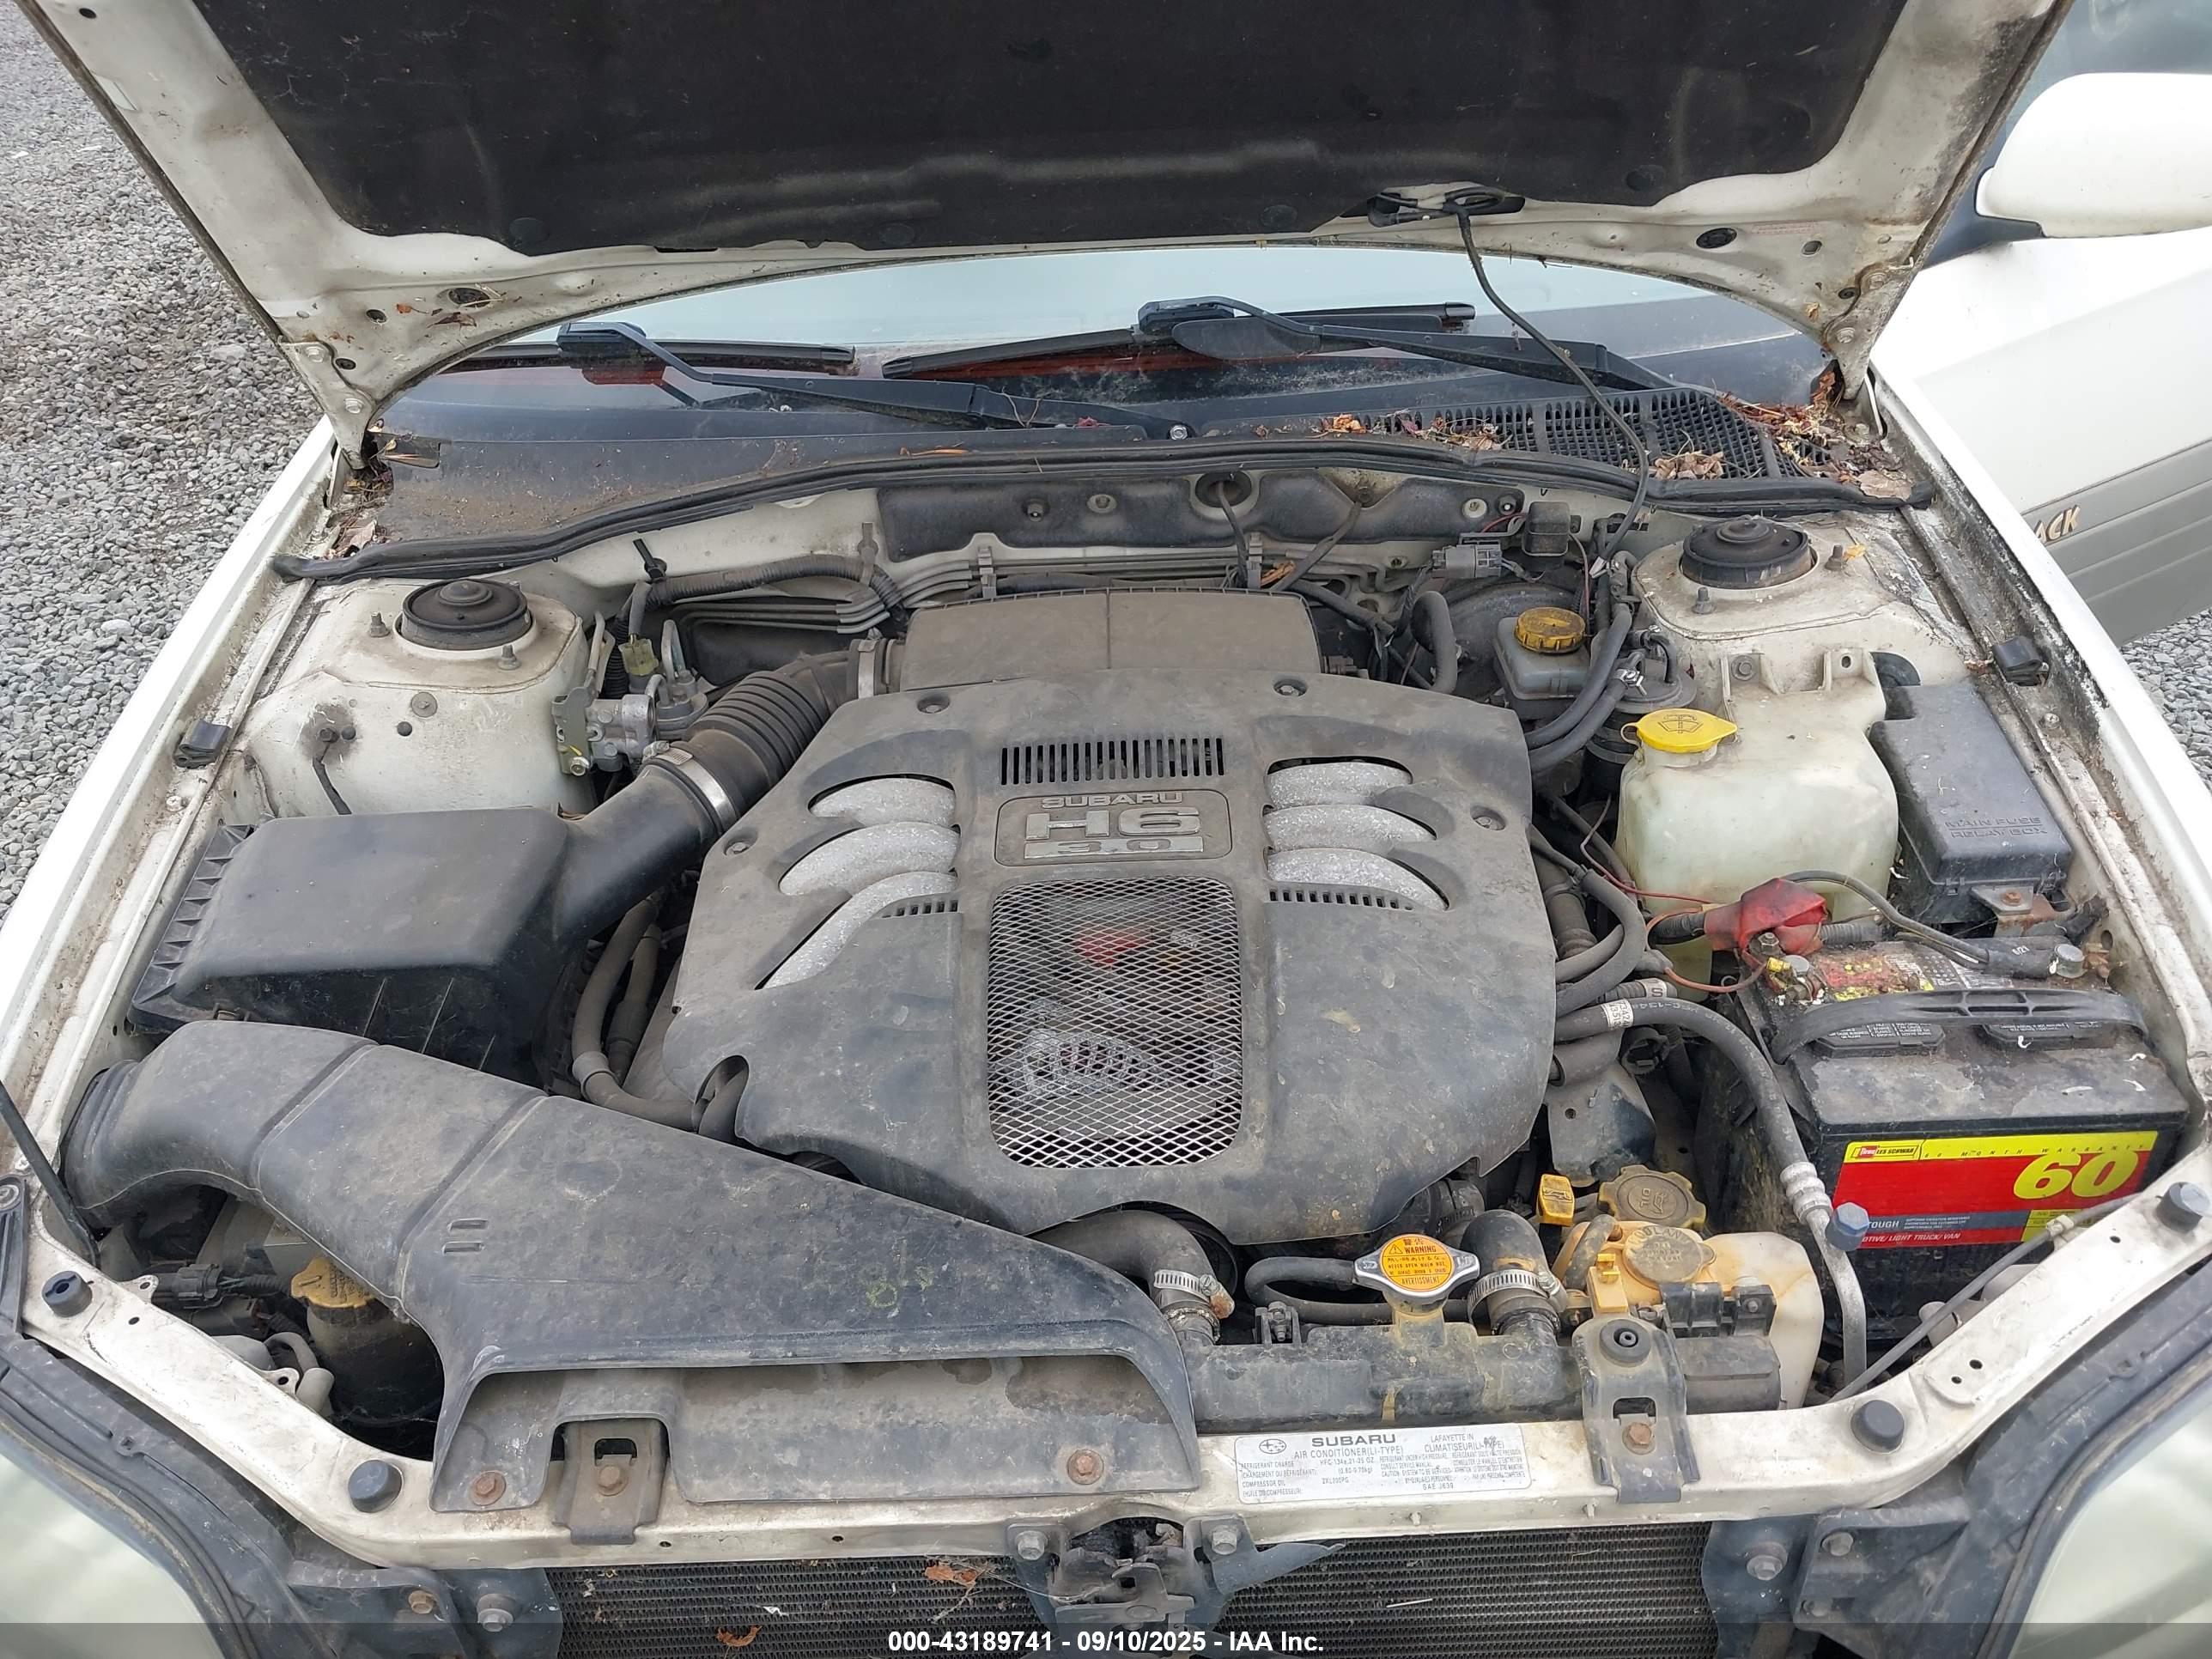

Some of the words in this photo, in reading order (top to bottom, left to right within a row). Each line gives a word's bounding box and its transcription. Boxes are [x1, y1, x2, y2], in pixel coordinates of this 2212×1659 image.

[1042, 792, 1182, 809] SUBARU
[1025, 806, 1202, 841] H6
[1944, 818, 1990, 828] MAIN
[1995, 817, 2041, 825] FUSE
[1950, 829, 2005, 839] RELAY
[2009, 827, 2048, 836] BOX
[2013, 1152, 2139, 1200] 60
[1639, 1188, 1650, 1208] OIL
[1404, 1245, 1437, 1254] WARNING
[1311, 1433, 1396, 1447] SUBARU
[1431, 1434, 1465, 1443] LAFAYETTE
[1294, 1449, 1308, 1459] AIR
[1310, 1445, 1404, 1459] CONDITIONER(LI-TYPE)
